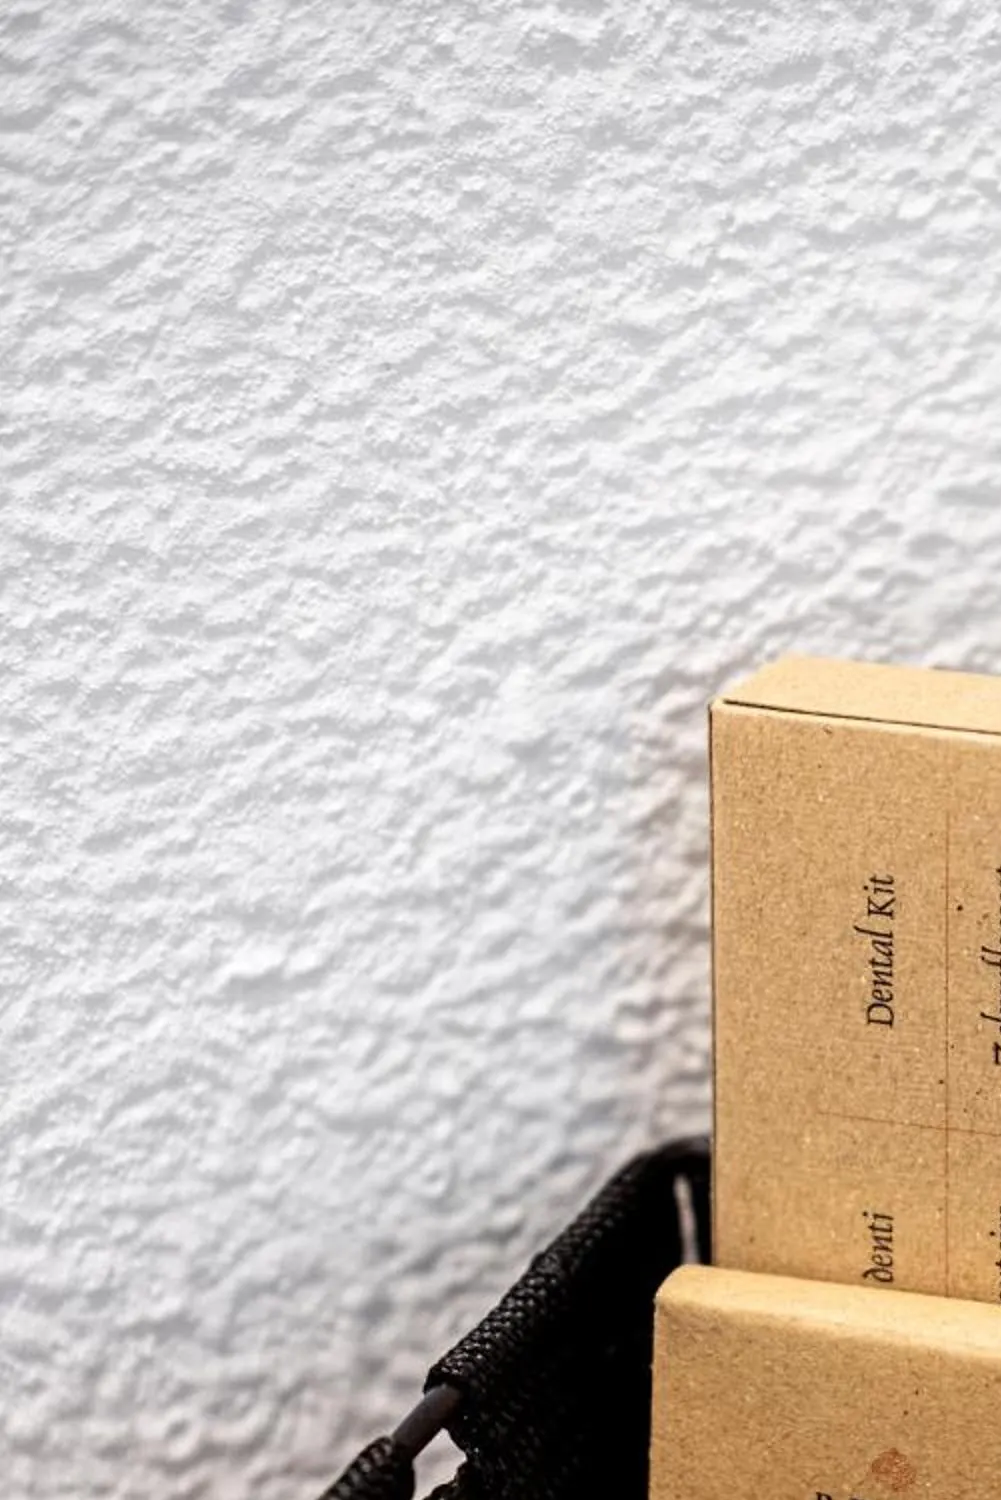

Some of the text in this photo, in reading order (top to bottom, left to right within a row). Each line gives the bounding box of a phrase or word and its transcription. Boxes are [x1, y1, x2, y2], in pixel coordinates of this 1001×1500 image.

[852, 873, 897, 1029] Dental Kit
[862, 1210, 895, 1284] denti
